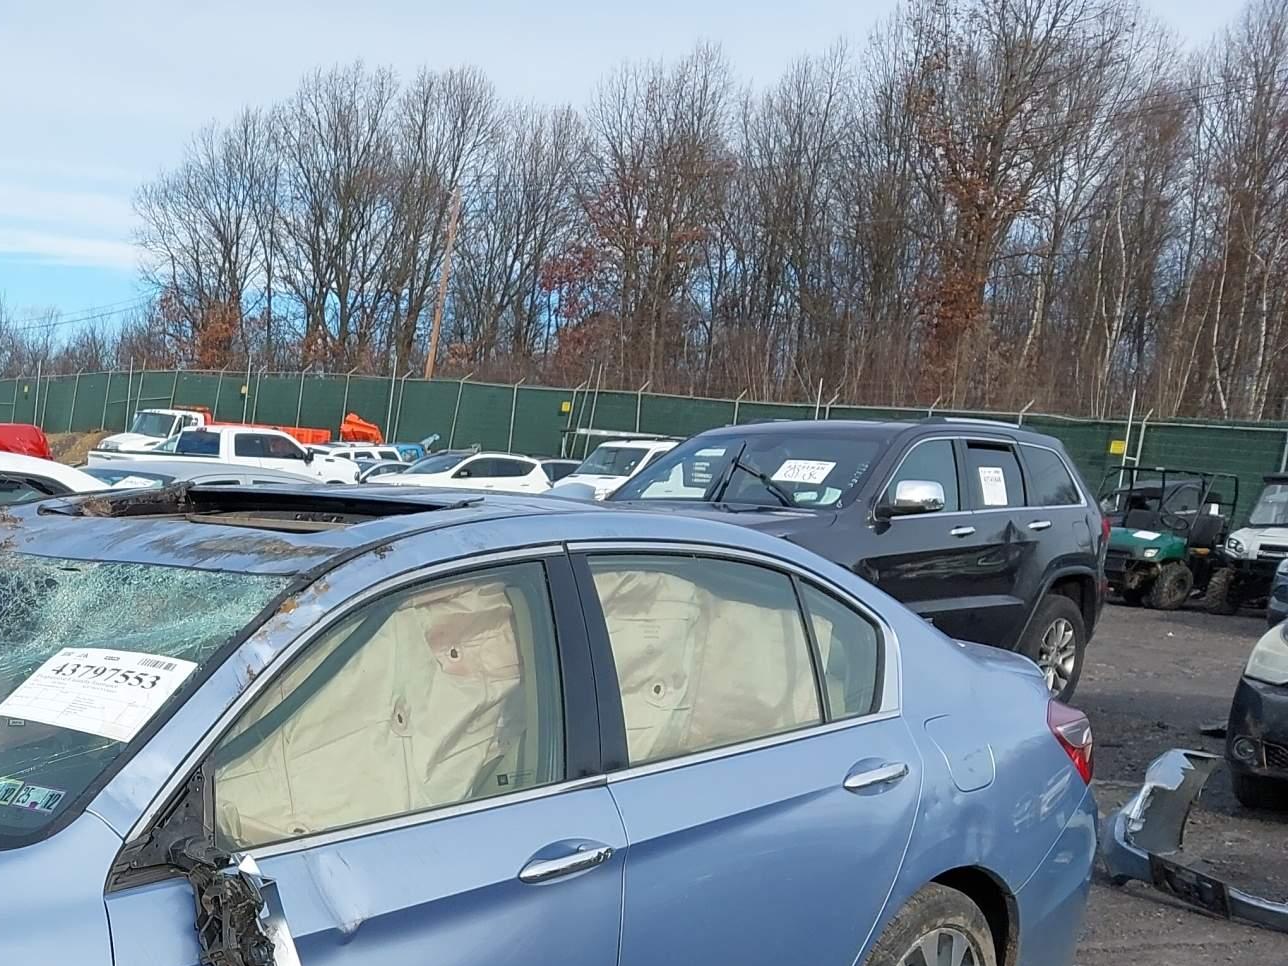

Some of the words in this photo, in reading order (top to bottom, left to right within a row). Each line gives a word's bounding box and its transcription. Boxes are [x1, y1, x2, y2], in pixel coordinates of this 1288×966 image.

[51, 662, 161, 689] 43797553
[0, 787, 16, 801] 12
[16, 786, 35, 804] 25
[44, 793, 62, 810] 12
